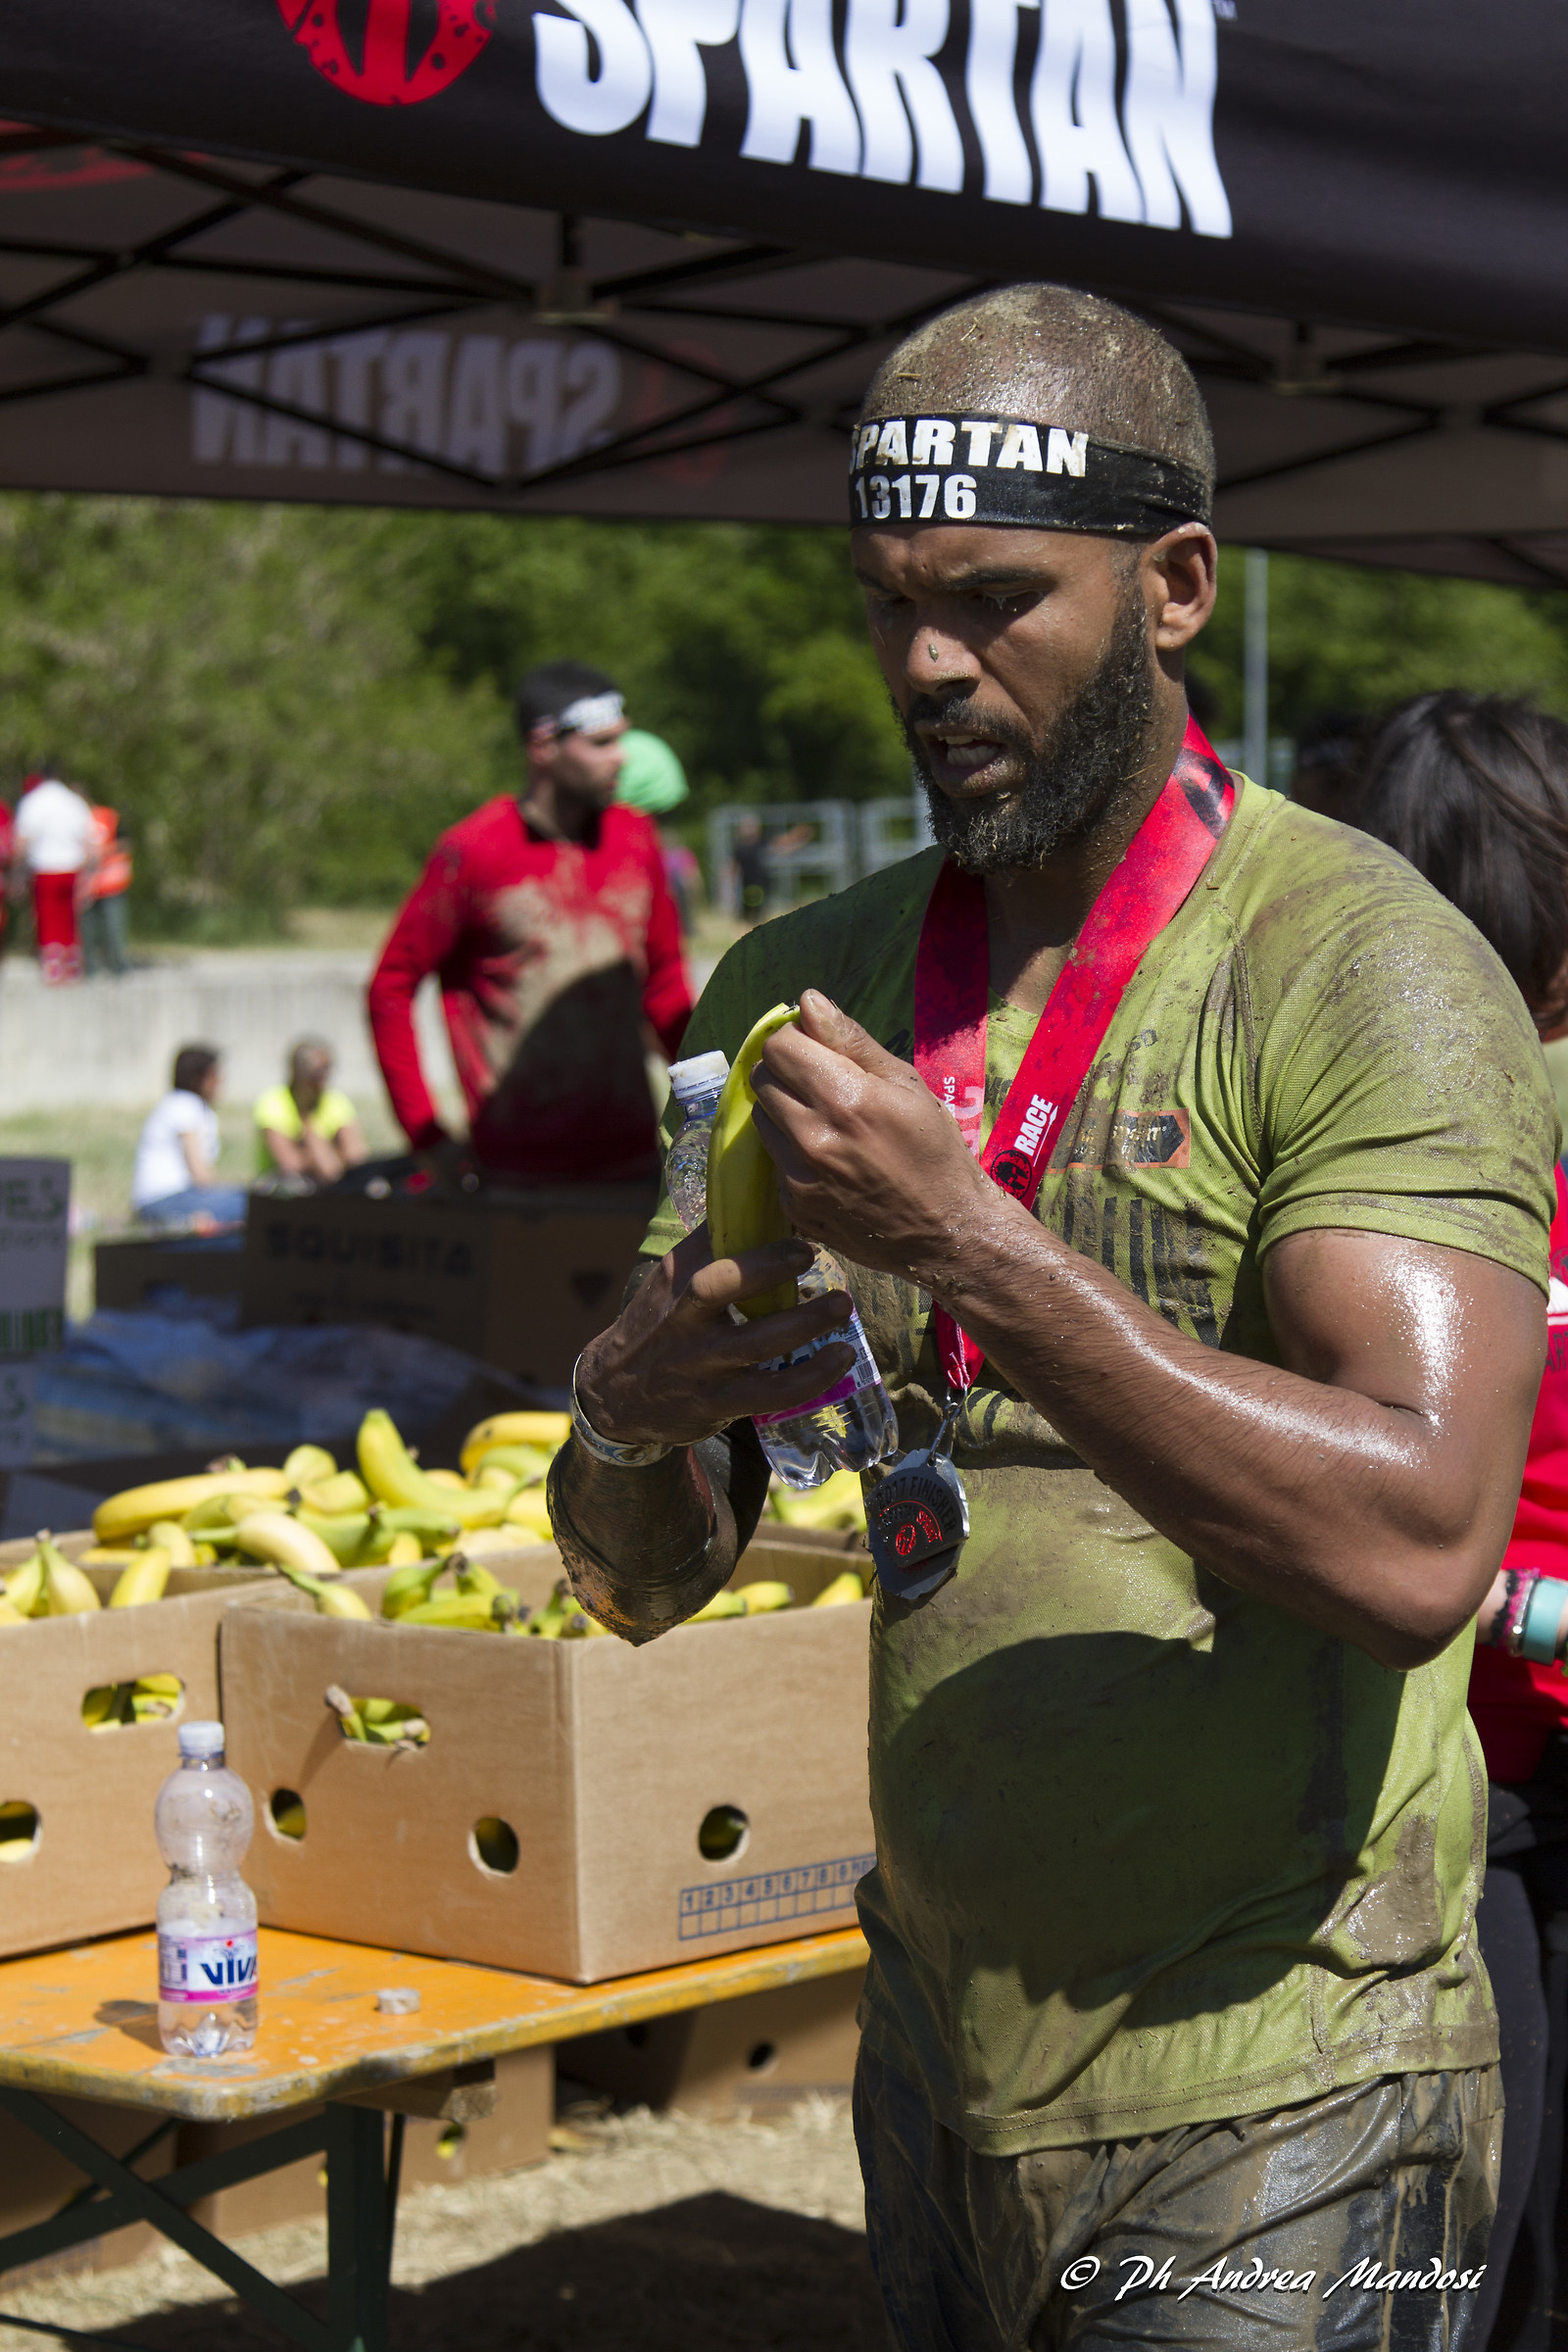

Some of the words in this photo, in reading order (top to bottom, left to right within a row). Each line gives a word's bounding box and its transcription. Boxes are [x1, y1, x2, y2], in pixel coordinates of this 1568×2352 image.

[533, 0, 1232, 238] SPARTAN
[856, 474, 977, 518] 13176
[1013, 1094, 1054, 1156] RACE
